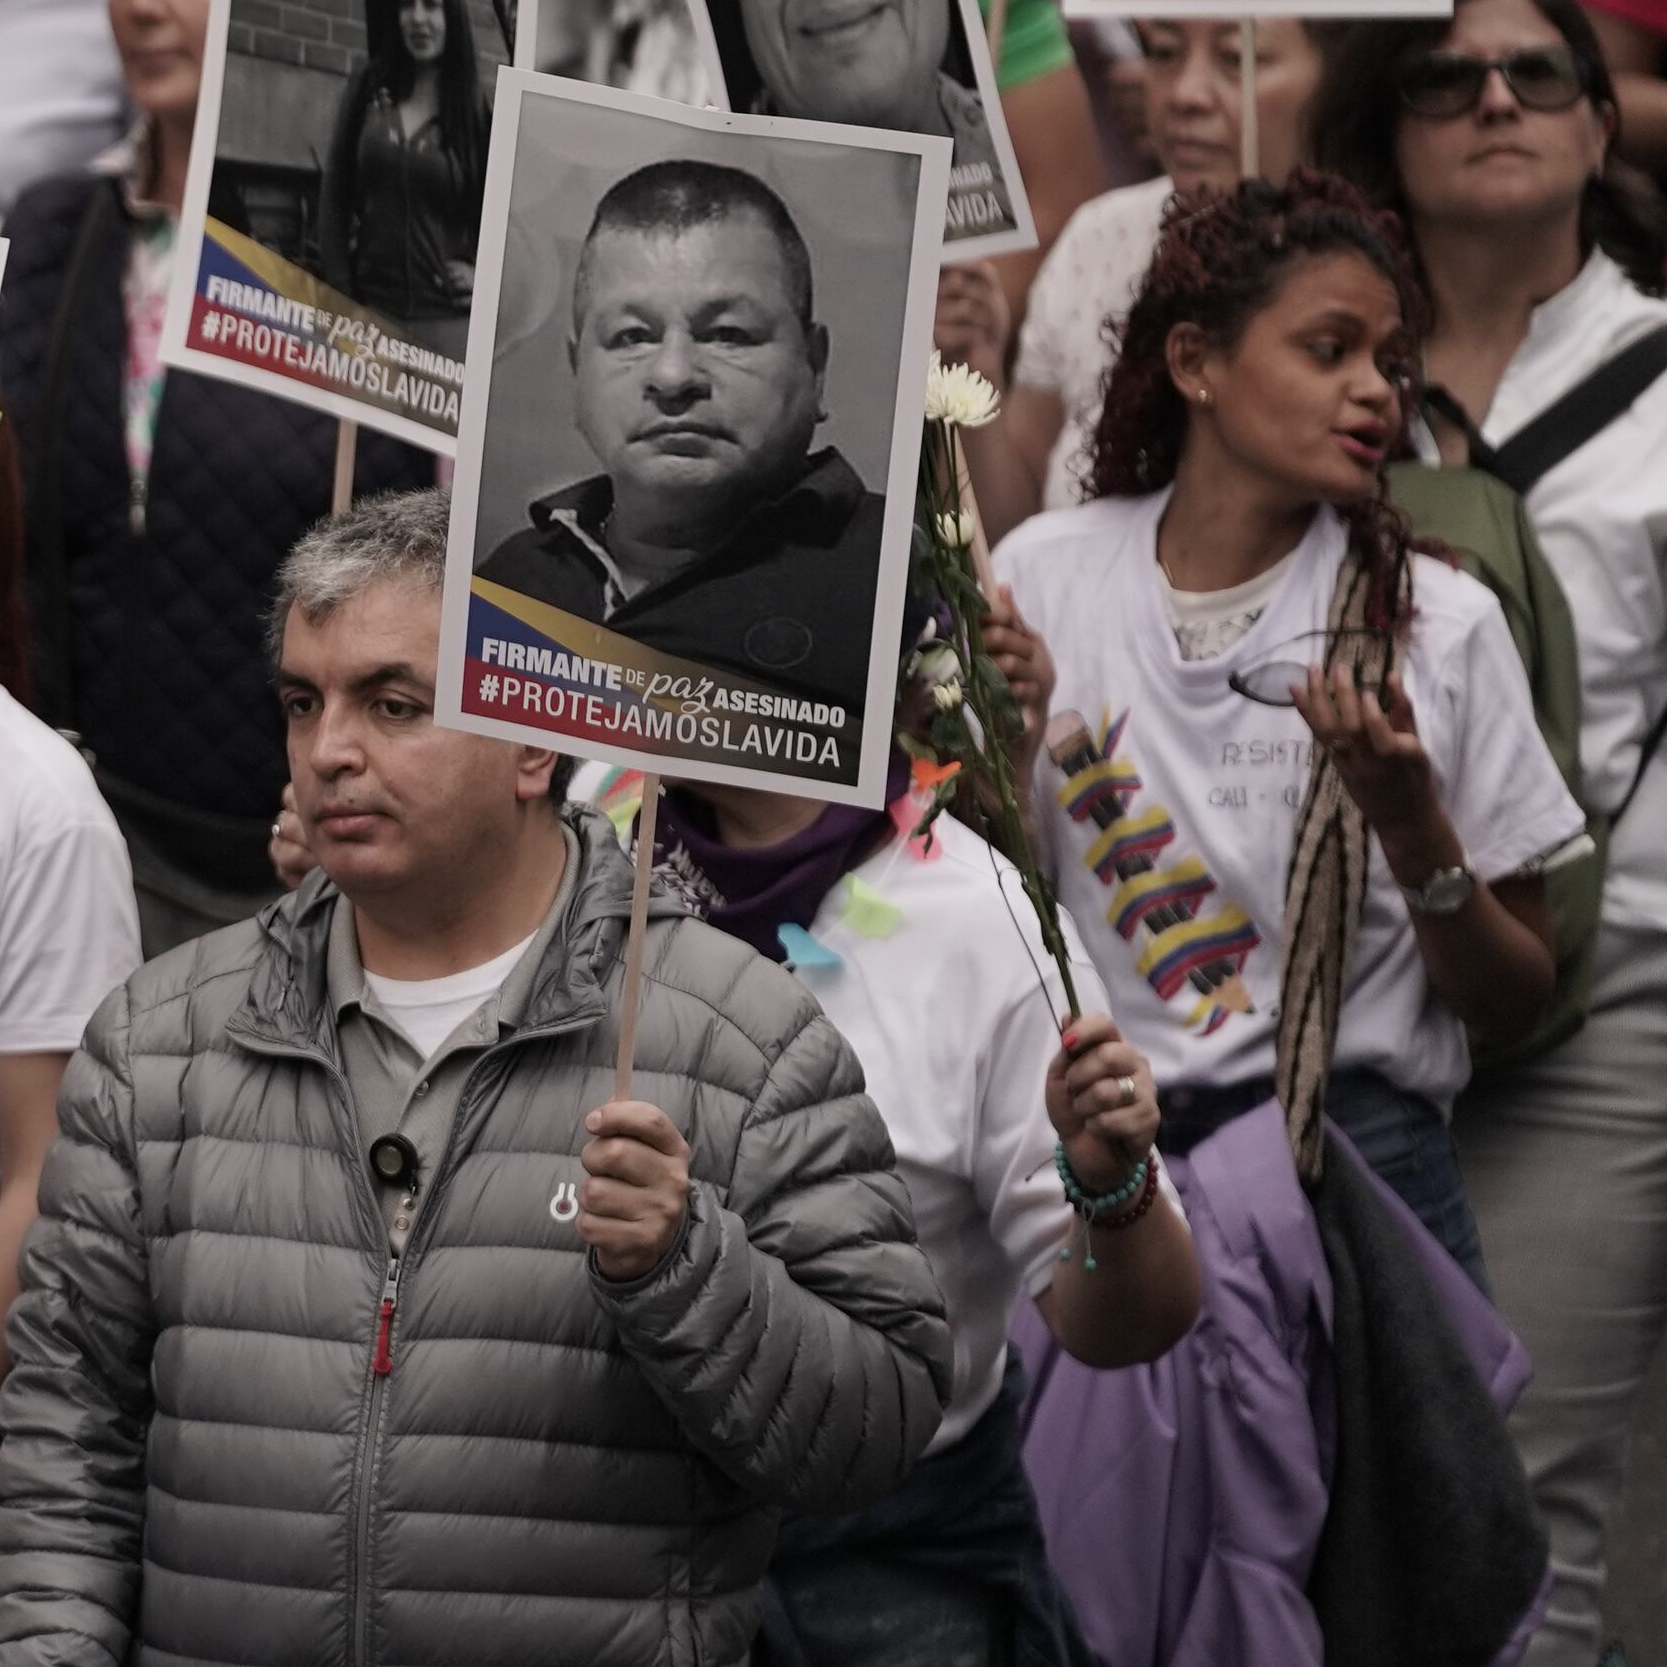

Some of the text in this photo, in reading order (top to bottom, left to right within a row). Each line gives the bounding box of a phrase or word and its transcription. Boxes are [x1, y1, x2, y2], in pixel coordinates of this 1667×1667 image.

[202, 309, 458, 424] #PROTEJAMOSLAVIDA
[207, 274, 315, 333] FIRMANTE
[327, 314, 380, 358] paz
[378, 335, 465, 384] ASESINADO
[479, 674, 841, 768] #PROTEJAMOSLAVIDA
[482, 637, 845, 728] FIRMANTE DE paz ASESINADO
